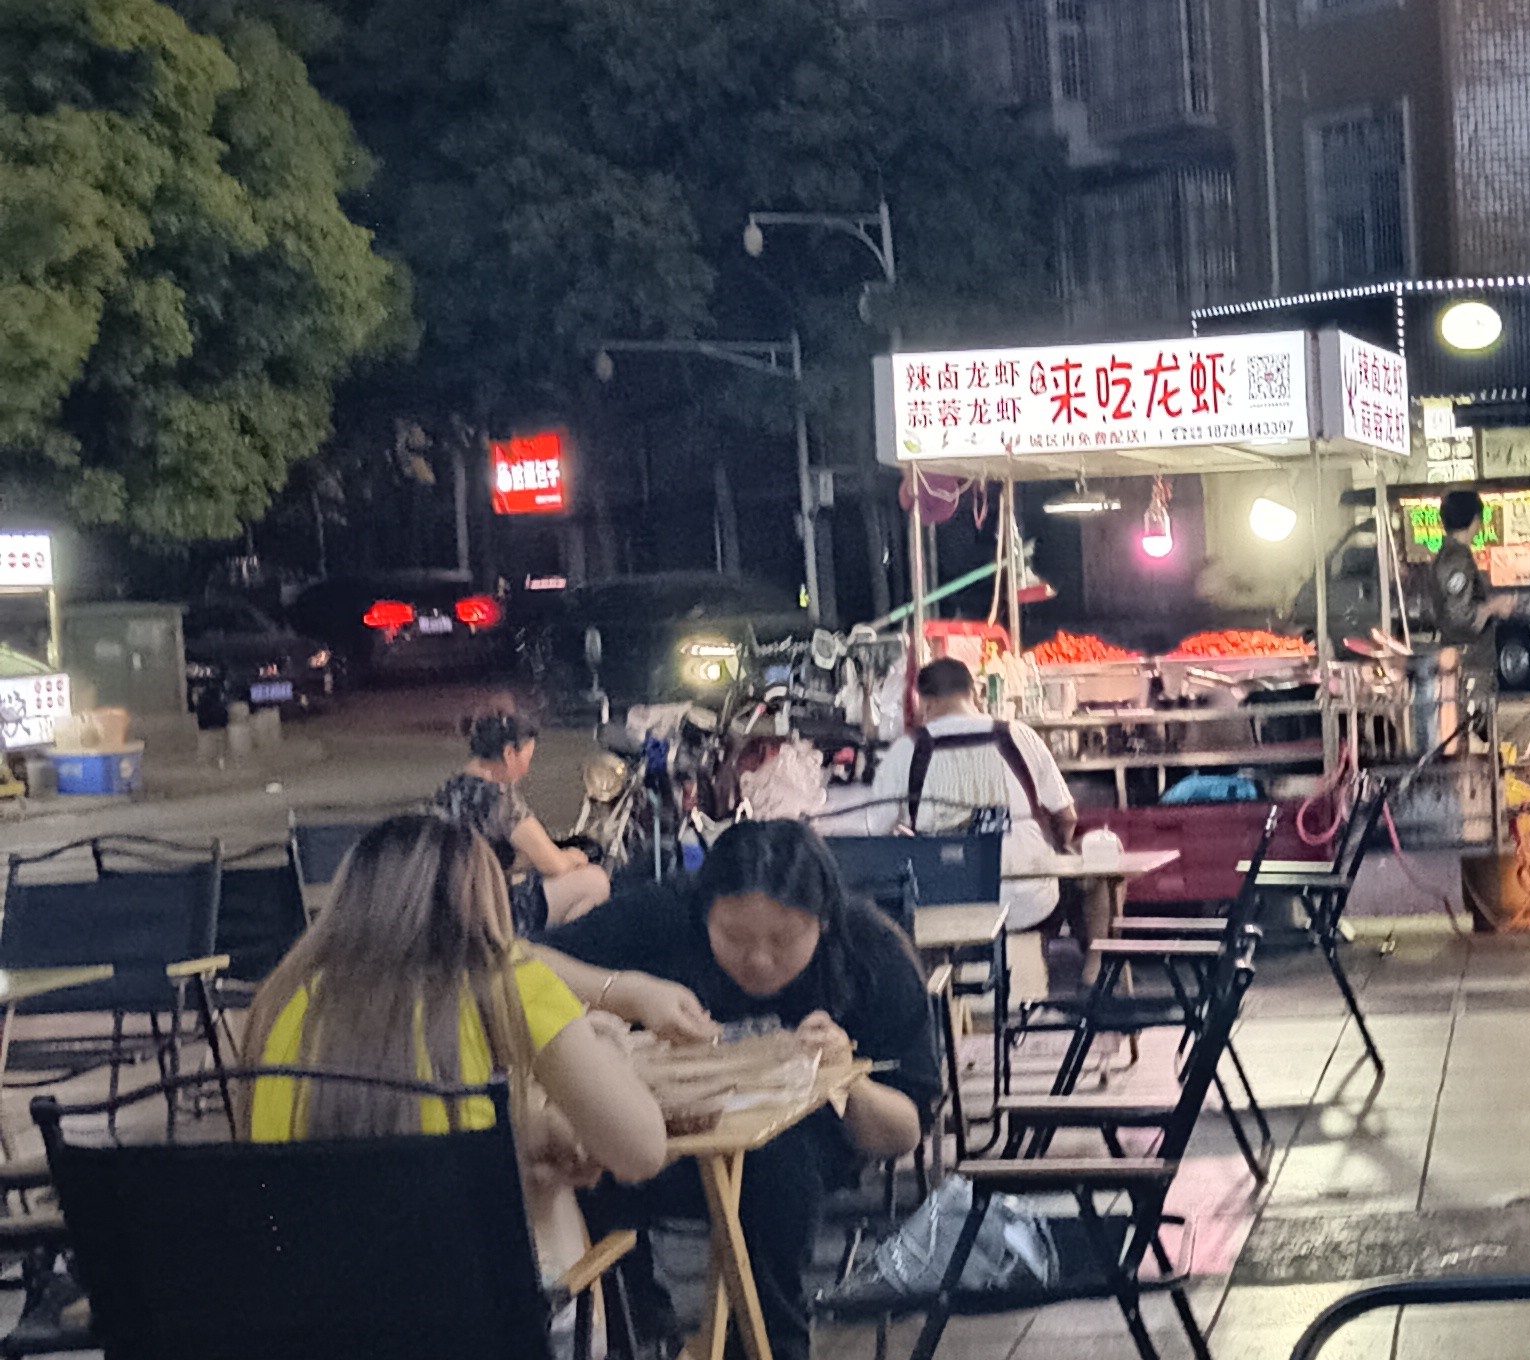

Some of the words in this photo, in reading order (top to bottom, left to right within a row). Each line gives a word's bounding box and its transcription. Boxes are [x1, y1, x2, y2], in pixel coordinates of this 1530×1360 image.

[906, 358, 1021, 393] 辣卤龙虾
[1050, 349, 1227, 424] 来吃龙虾
[907, 395, 1022, 429] 蒜蓉龙虾
